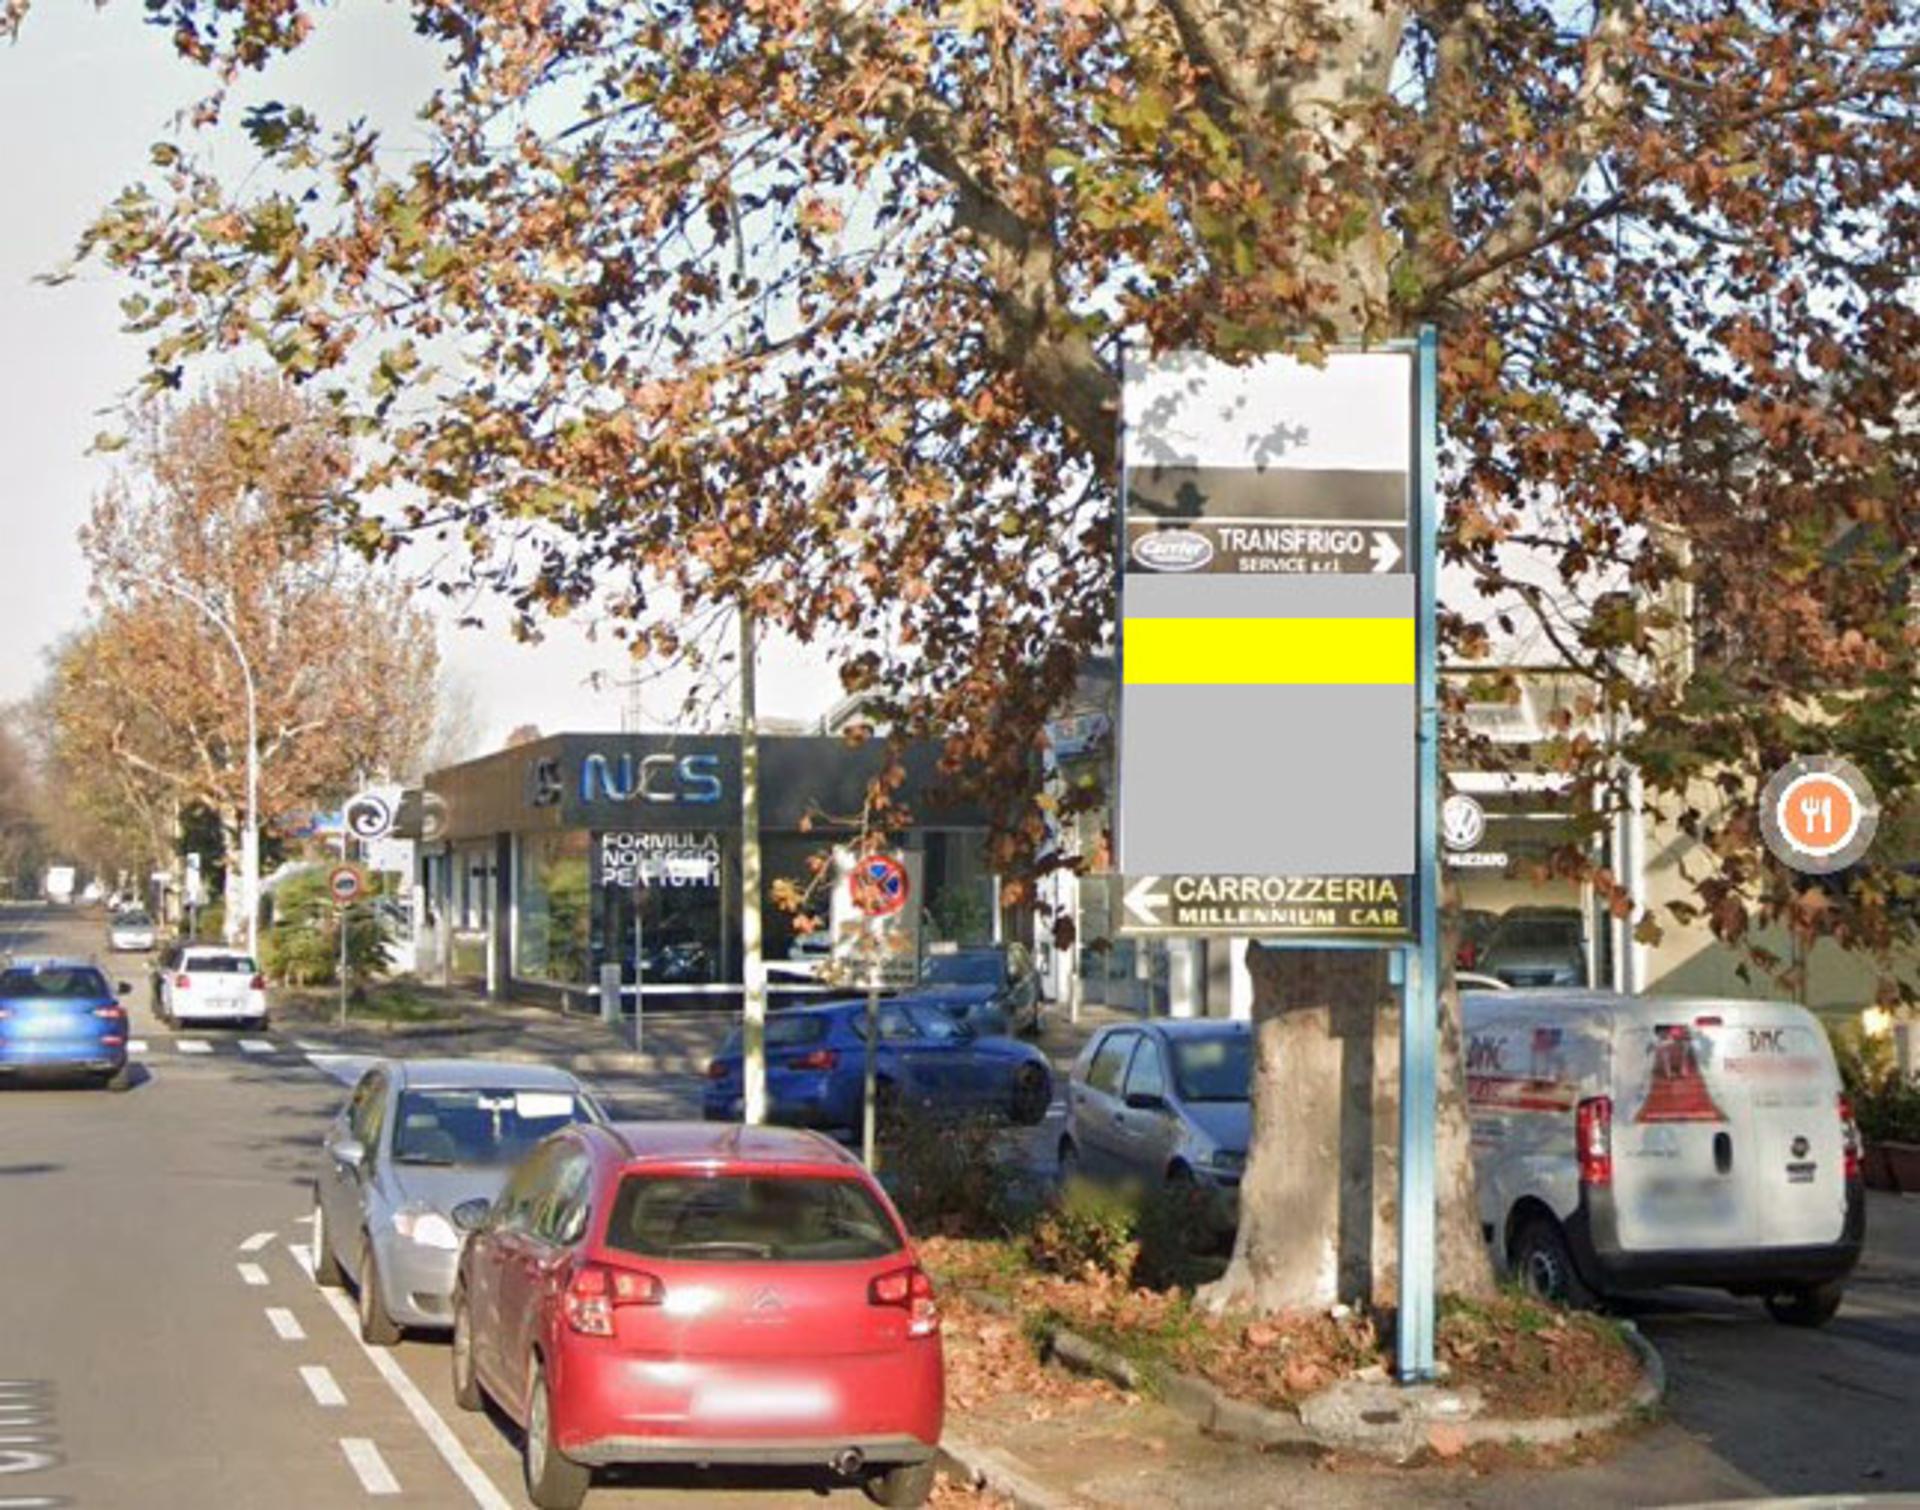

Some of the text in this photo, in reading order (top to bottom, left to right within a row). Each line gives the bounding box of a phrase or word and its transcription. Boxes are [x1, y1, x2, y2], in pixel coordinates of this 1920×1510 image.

[1218, 528, 1365, 554] TRANSFRIGO
[1238, 556, 1306, 573] SERVICE
[580, 753, 722, 803] NCS
[602, 832, 719, 850] FORMULA
[1173, 876, 1399, 902] CARROZZERIA
[1178, 907, 1399, 926] MILLENNIUM CAR
